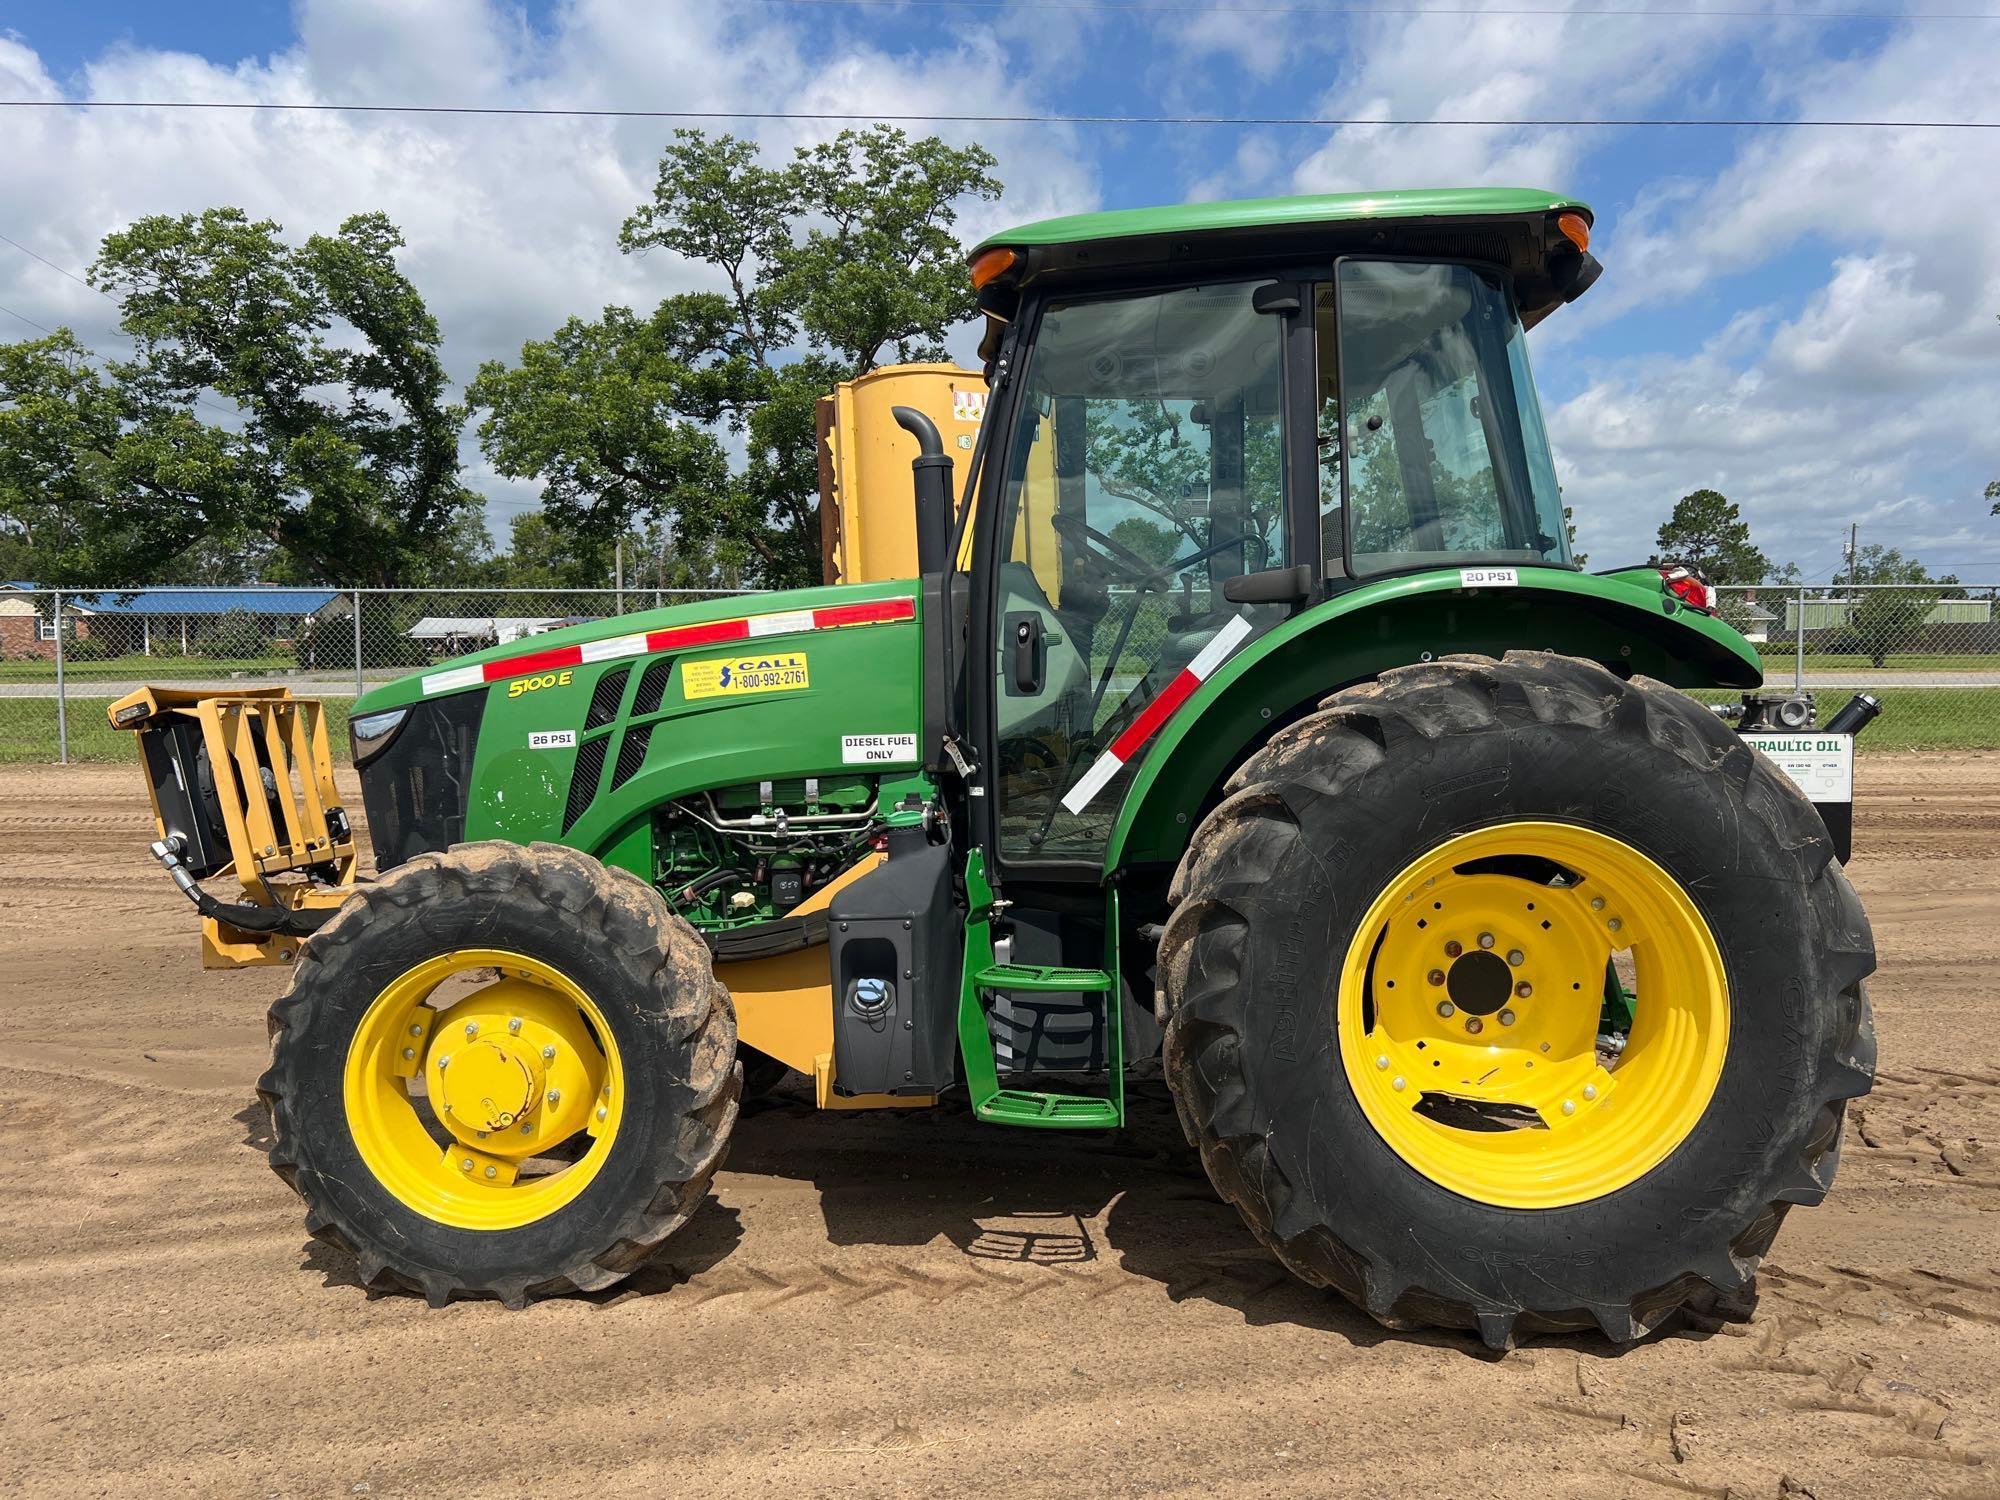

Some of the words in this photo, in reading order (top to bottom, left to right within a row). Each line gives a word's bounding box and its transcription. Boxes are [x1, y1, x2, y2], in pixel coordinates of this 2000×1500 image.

[1466, 572, 1484, 581] 20
[1488, 571, 1513, 581] PSI
[739, 659, 802, 671] CALL
[733, 670, 806, 689] 1-800-992-2761
[533, 735, 548, 745] 26
[551, 733, 572, 744] PSI
[845, 737, 885, 747] DIESEL
[888, 736, 913, 746] FUEL
[1816, 740, 1842, 752] OIL
[866, 750, 893, 759] ONLY
